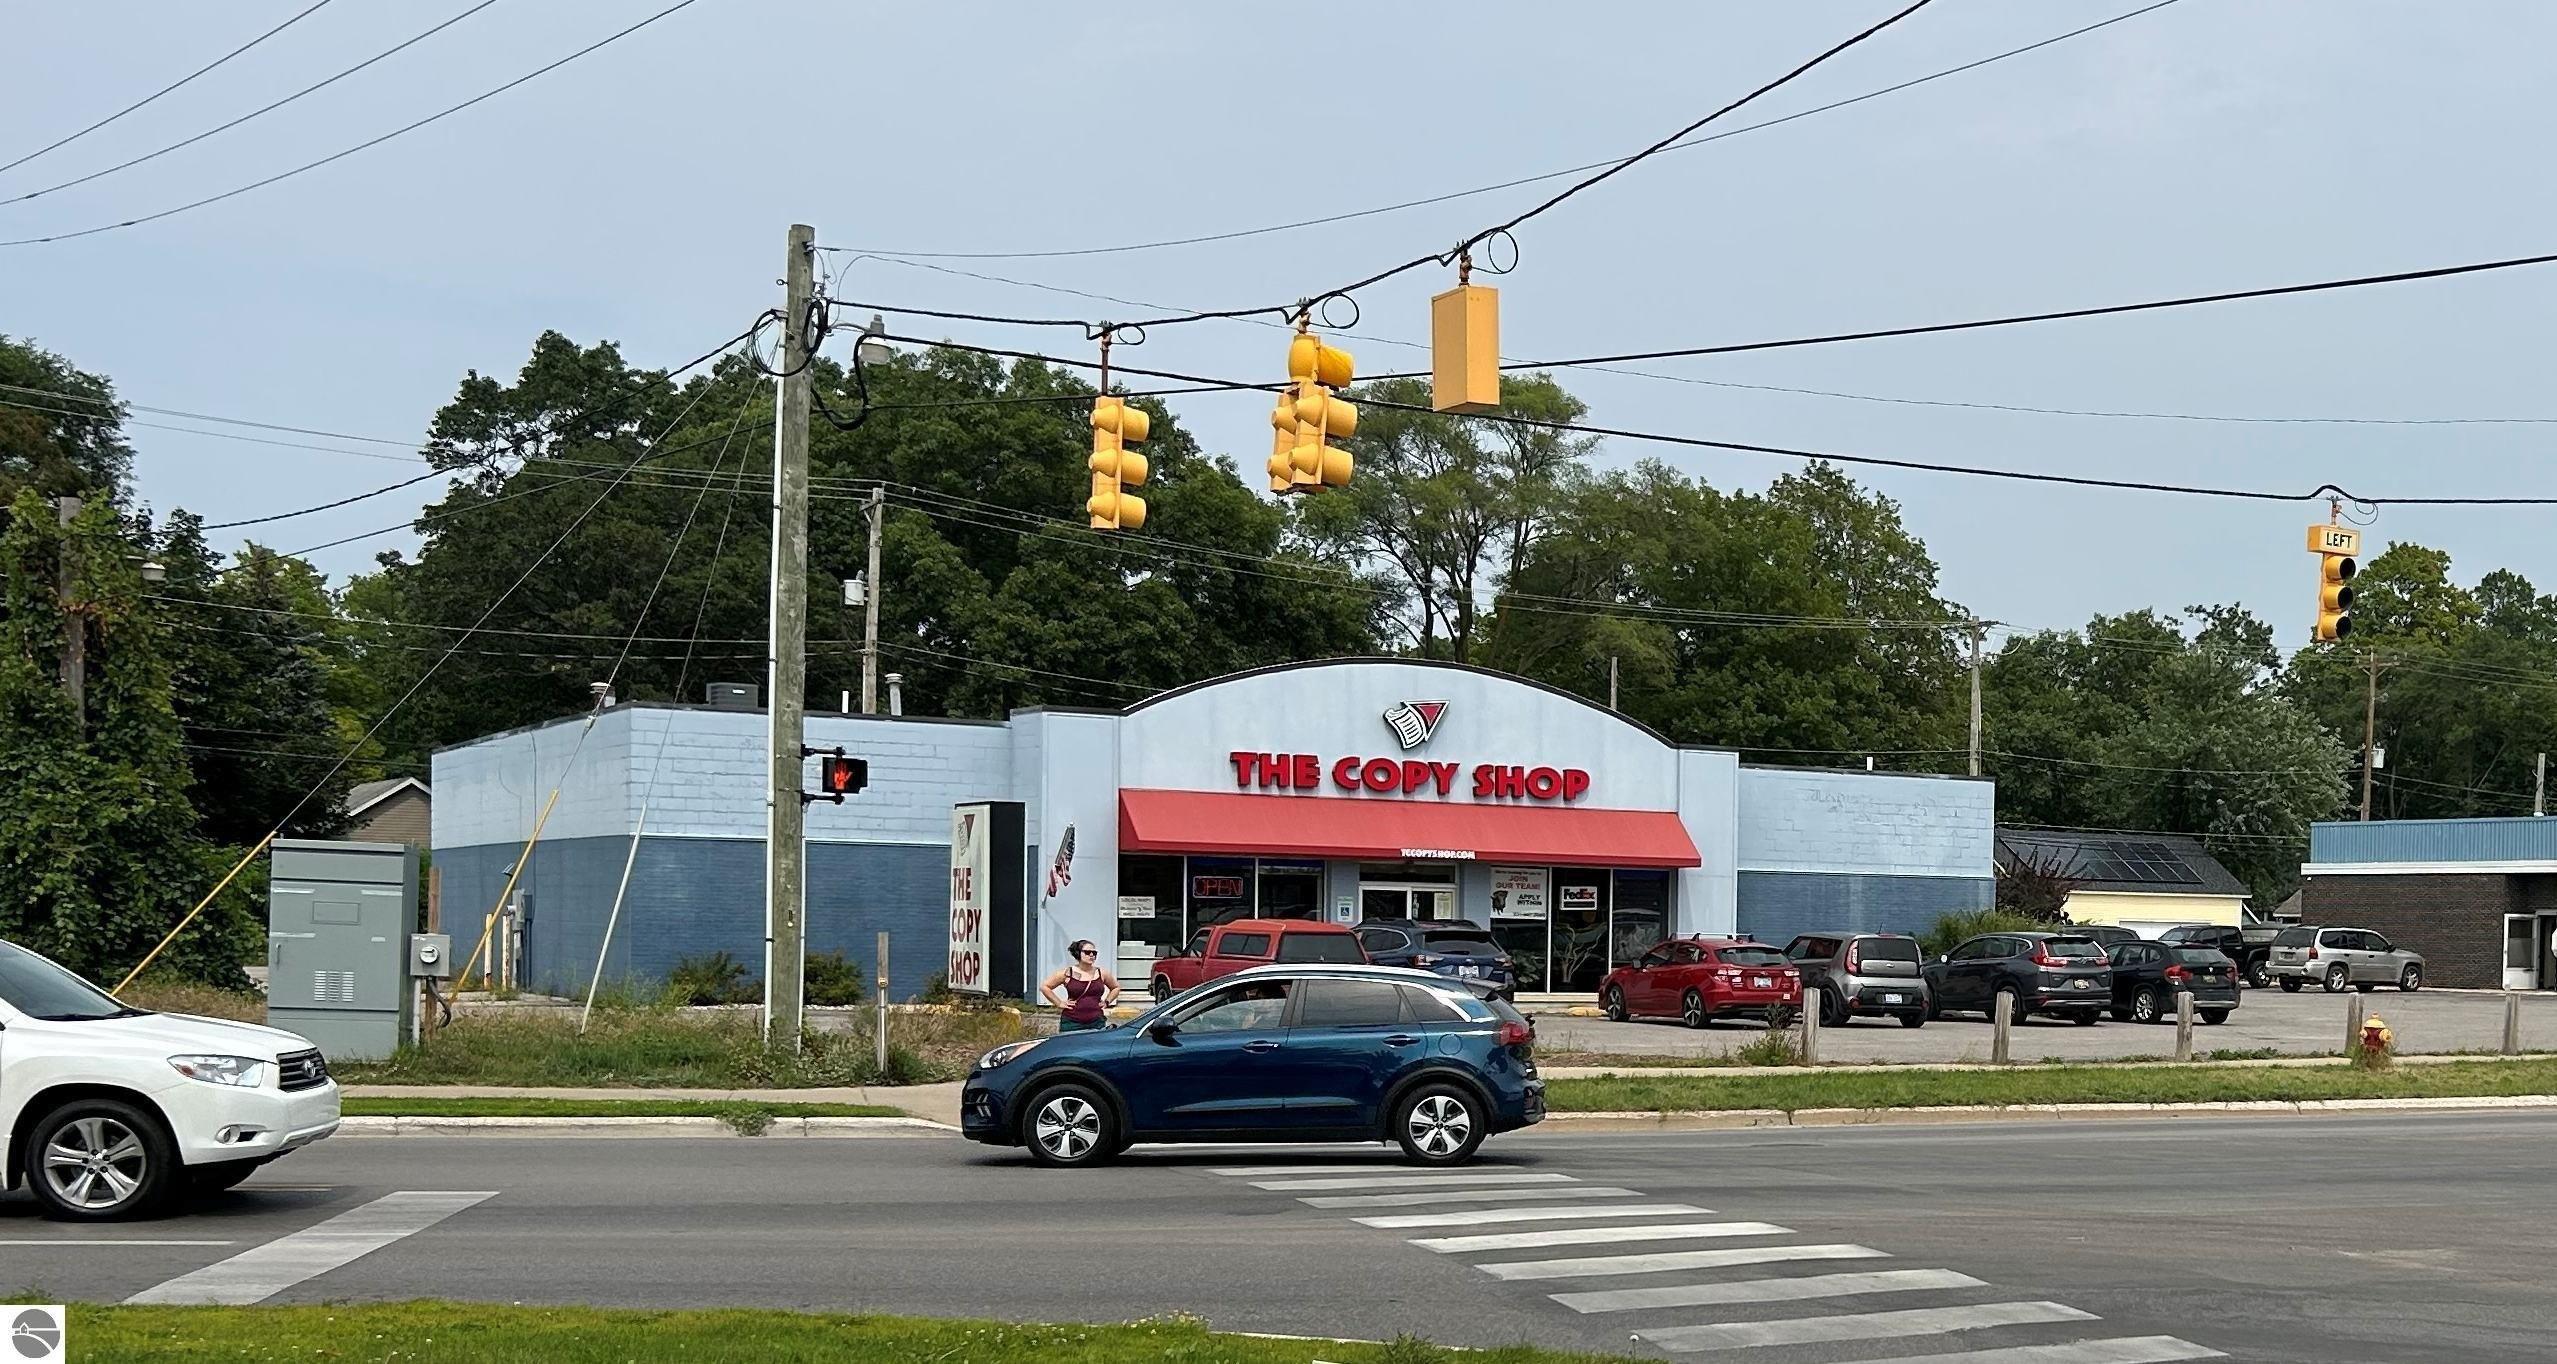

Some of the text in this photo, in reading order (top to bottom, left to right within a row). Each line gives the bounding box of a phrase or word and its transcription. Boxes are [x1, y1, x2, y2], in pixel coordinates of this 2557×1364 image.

[2326, 532, 2352, 548] LEFT
[1230, 752, 1590, 801] THE COPY SHOP
[953, 867, 972, 901] THE
[1193, 879, 1243, 896] OPEN
[1563, 888, 1596, 900] FedEx
[951, 908, 982, 944] COPY
[950, 951, 980, 986] SHOP
